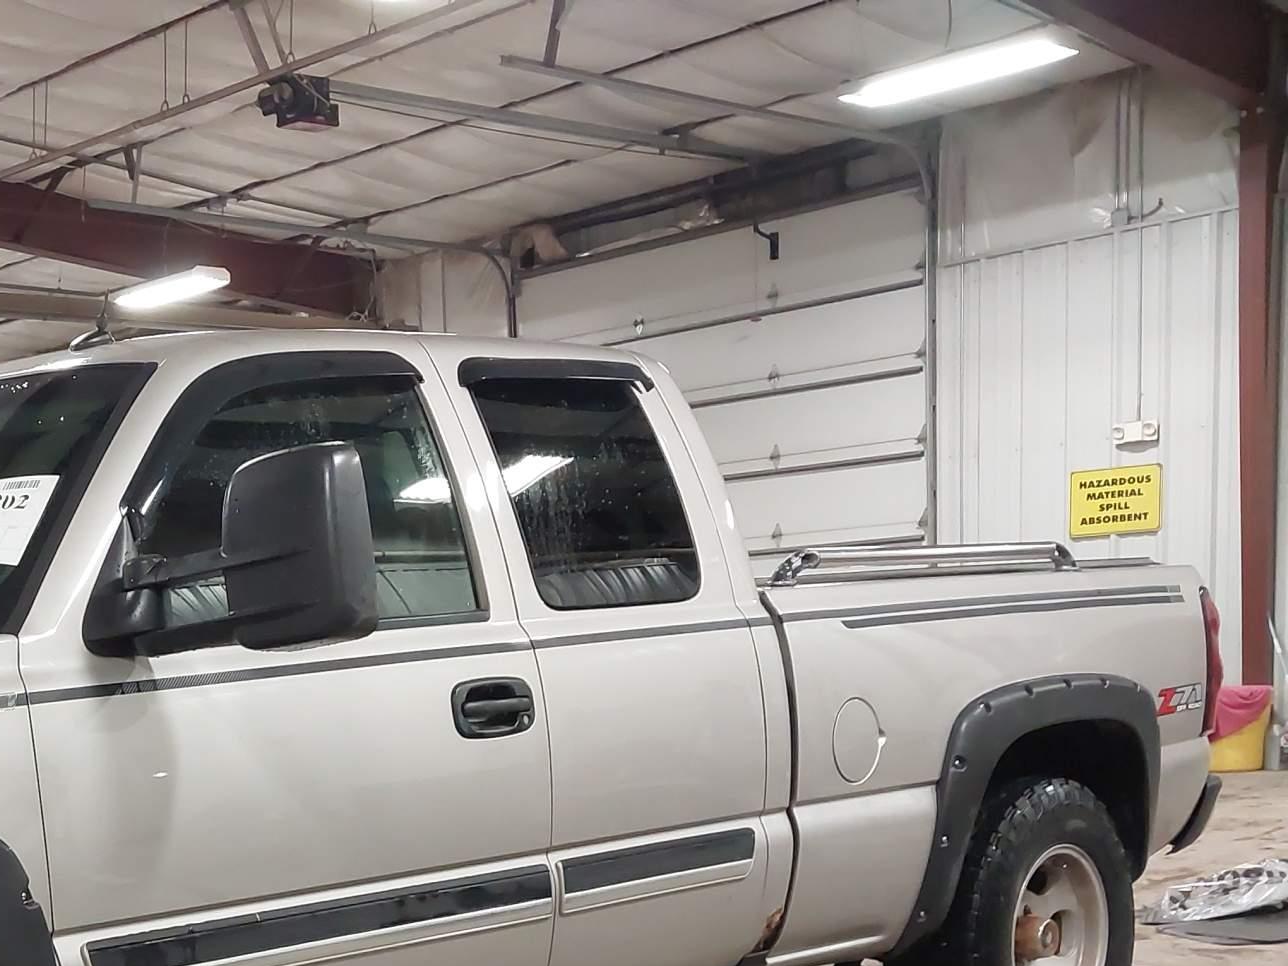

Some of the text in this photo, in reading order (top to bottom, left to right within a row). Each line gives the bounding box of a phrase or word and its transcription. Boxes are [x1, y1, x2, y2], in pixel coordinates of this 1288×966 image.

[1079, 474, 1152, 490] HAZARDOUS
[1086, 488, 1144, 501] MATERIAL
[1098, 501, 1130, 512] SPILL
[1079, 512, 1149, 526] ABSORBENT
[1156, 682, 1203, 717] Z71
